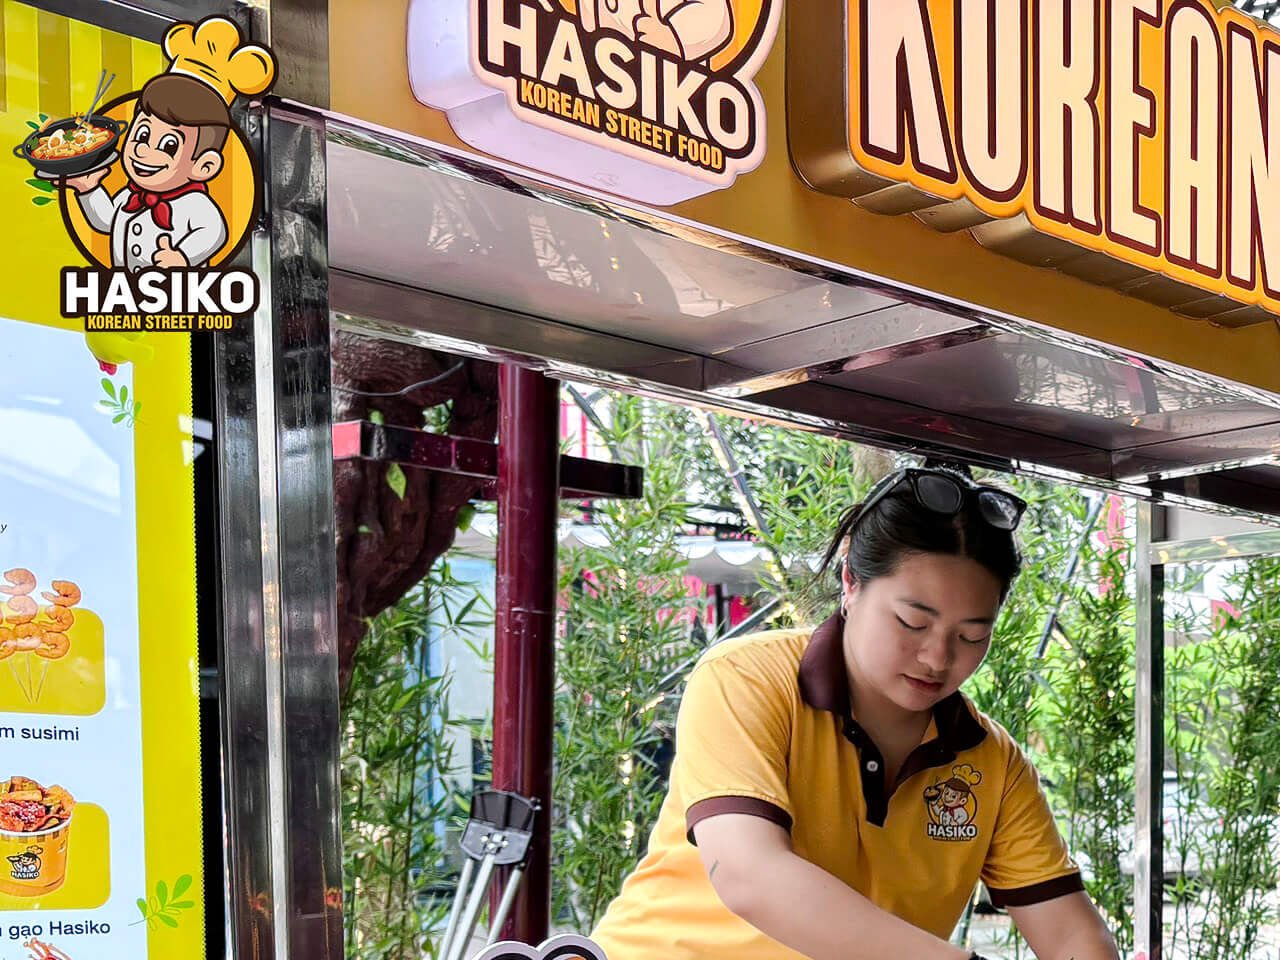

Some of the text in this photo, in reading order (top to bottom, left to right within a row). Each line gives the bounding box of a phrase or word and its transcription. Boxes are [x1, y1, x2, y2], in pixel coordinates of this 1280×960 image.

[487, 0, 749, 150] HASIKO
[521, 79, 723, 170] KOREAN STREET FOOD
[21, 725, 79, 741] susimi
[928, 824, 976, 837] HASIKO
[9, 925, 43, 940] gạo
[49, 920, 111, 935] Hasiko
